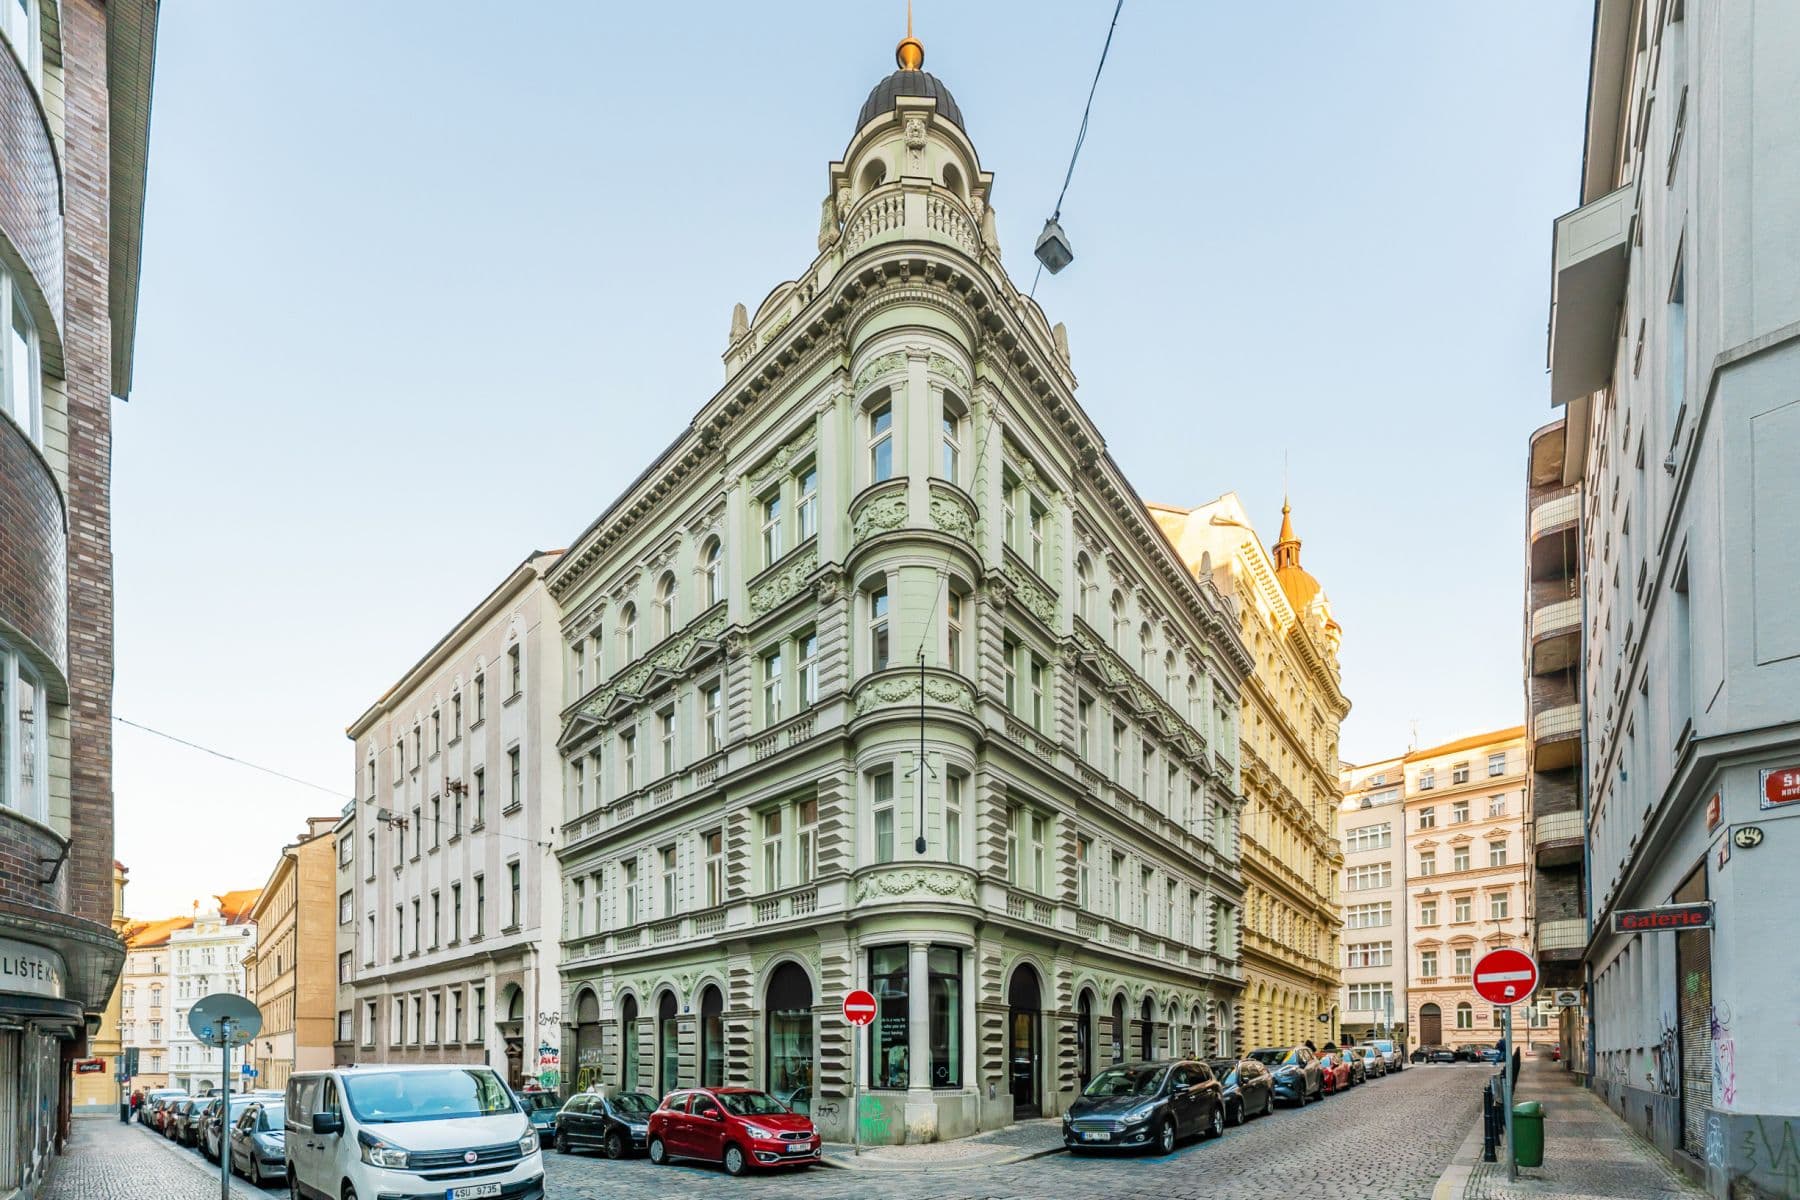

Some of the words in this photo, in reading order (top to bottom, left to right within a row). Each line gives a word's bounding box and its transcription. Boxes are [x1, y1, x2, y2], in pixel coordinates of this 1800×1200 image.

[1623, 911, 1704, 929] Galerie
[455, 1187, 471, 1198] 4SU
[476, 1184, 497, 1195] 9735
